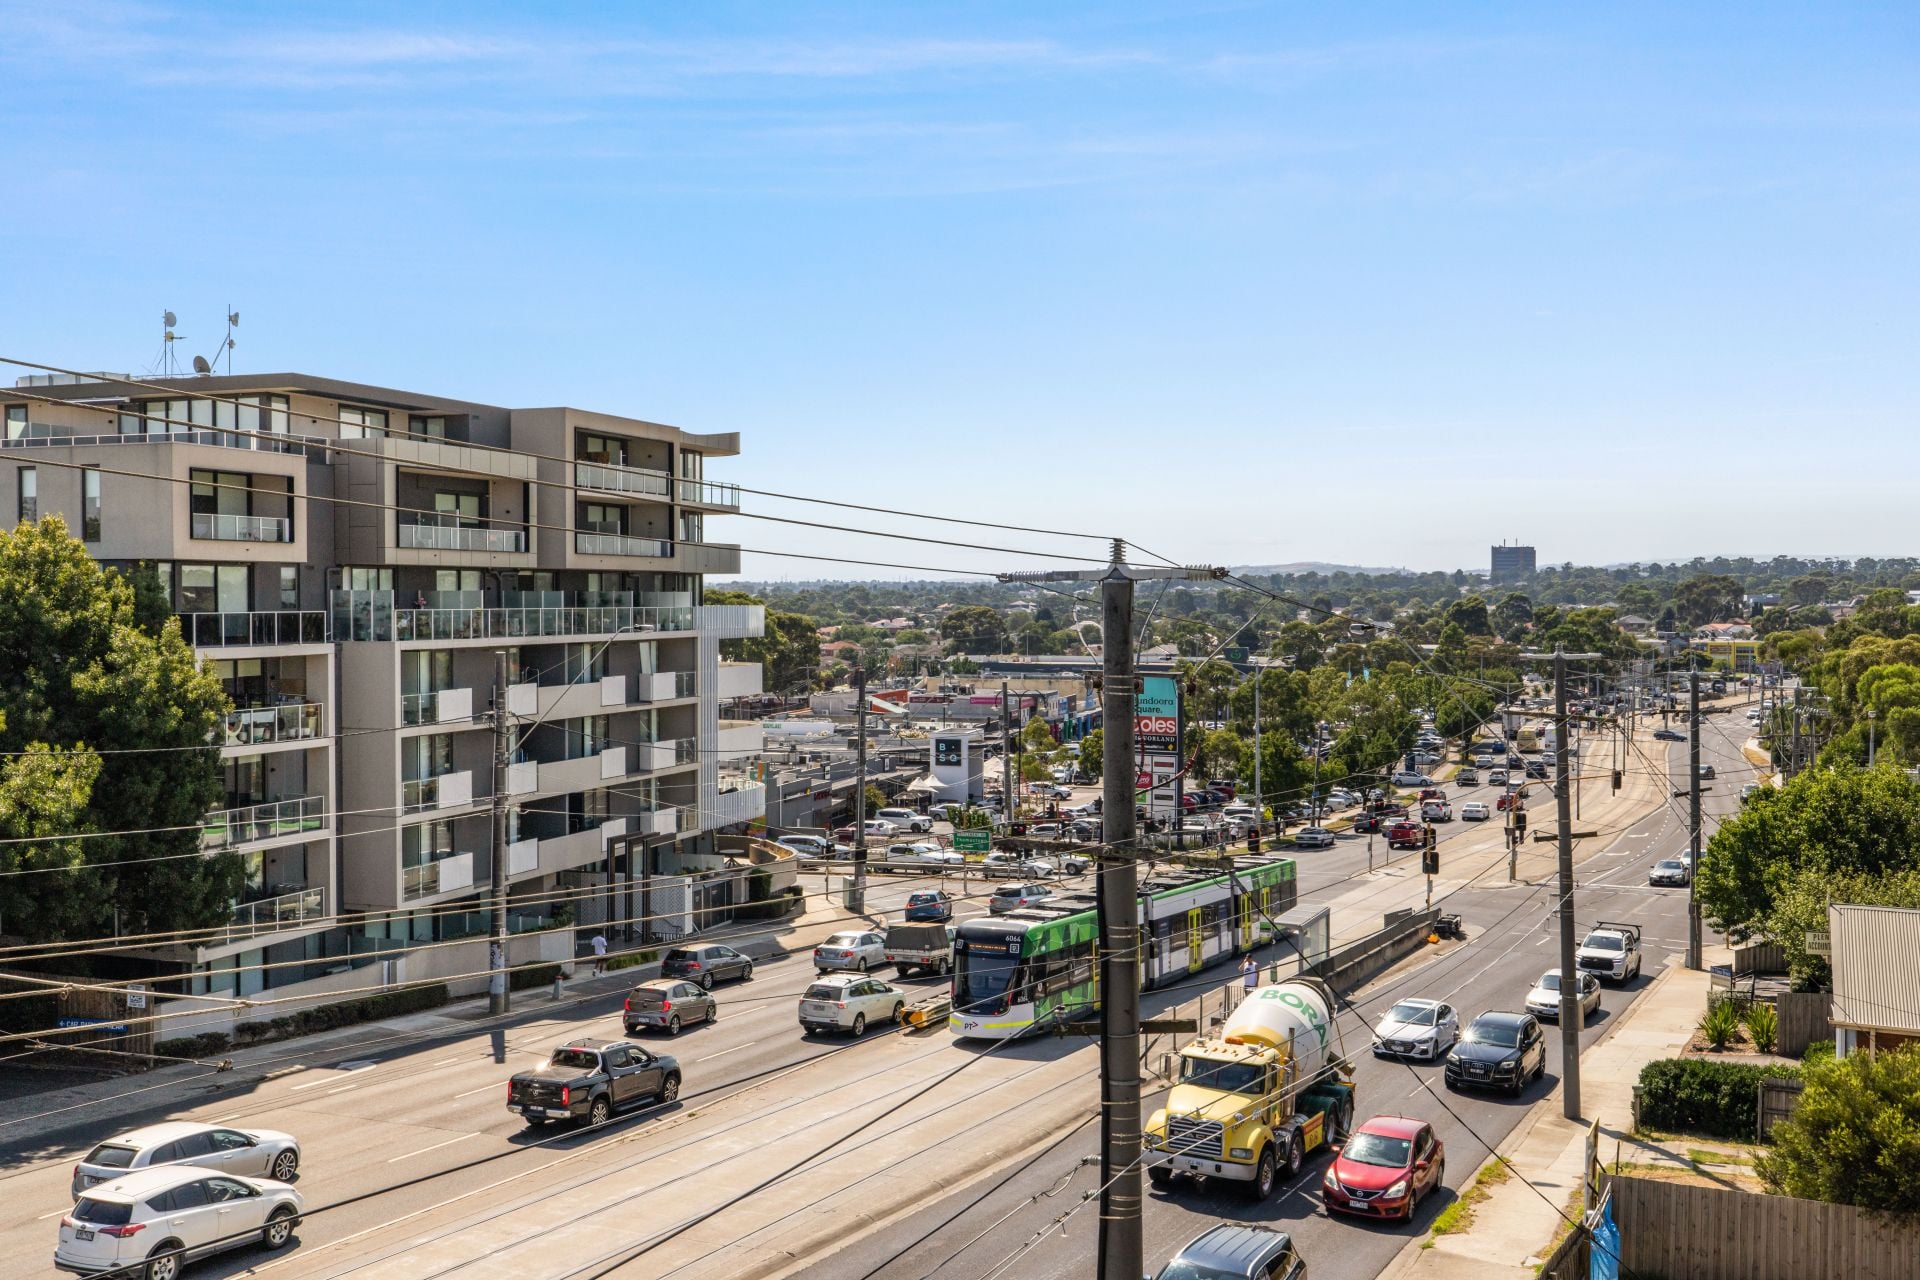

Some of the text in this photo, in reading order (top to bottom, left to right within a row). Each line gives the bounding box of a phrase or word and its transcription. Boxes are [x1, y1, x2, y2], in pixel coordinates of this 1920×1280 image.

[1134, 697, 1174, 705] undoora
[1134, 706, 1163, 714] quare.
[939, 743, 946, 751] B
